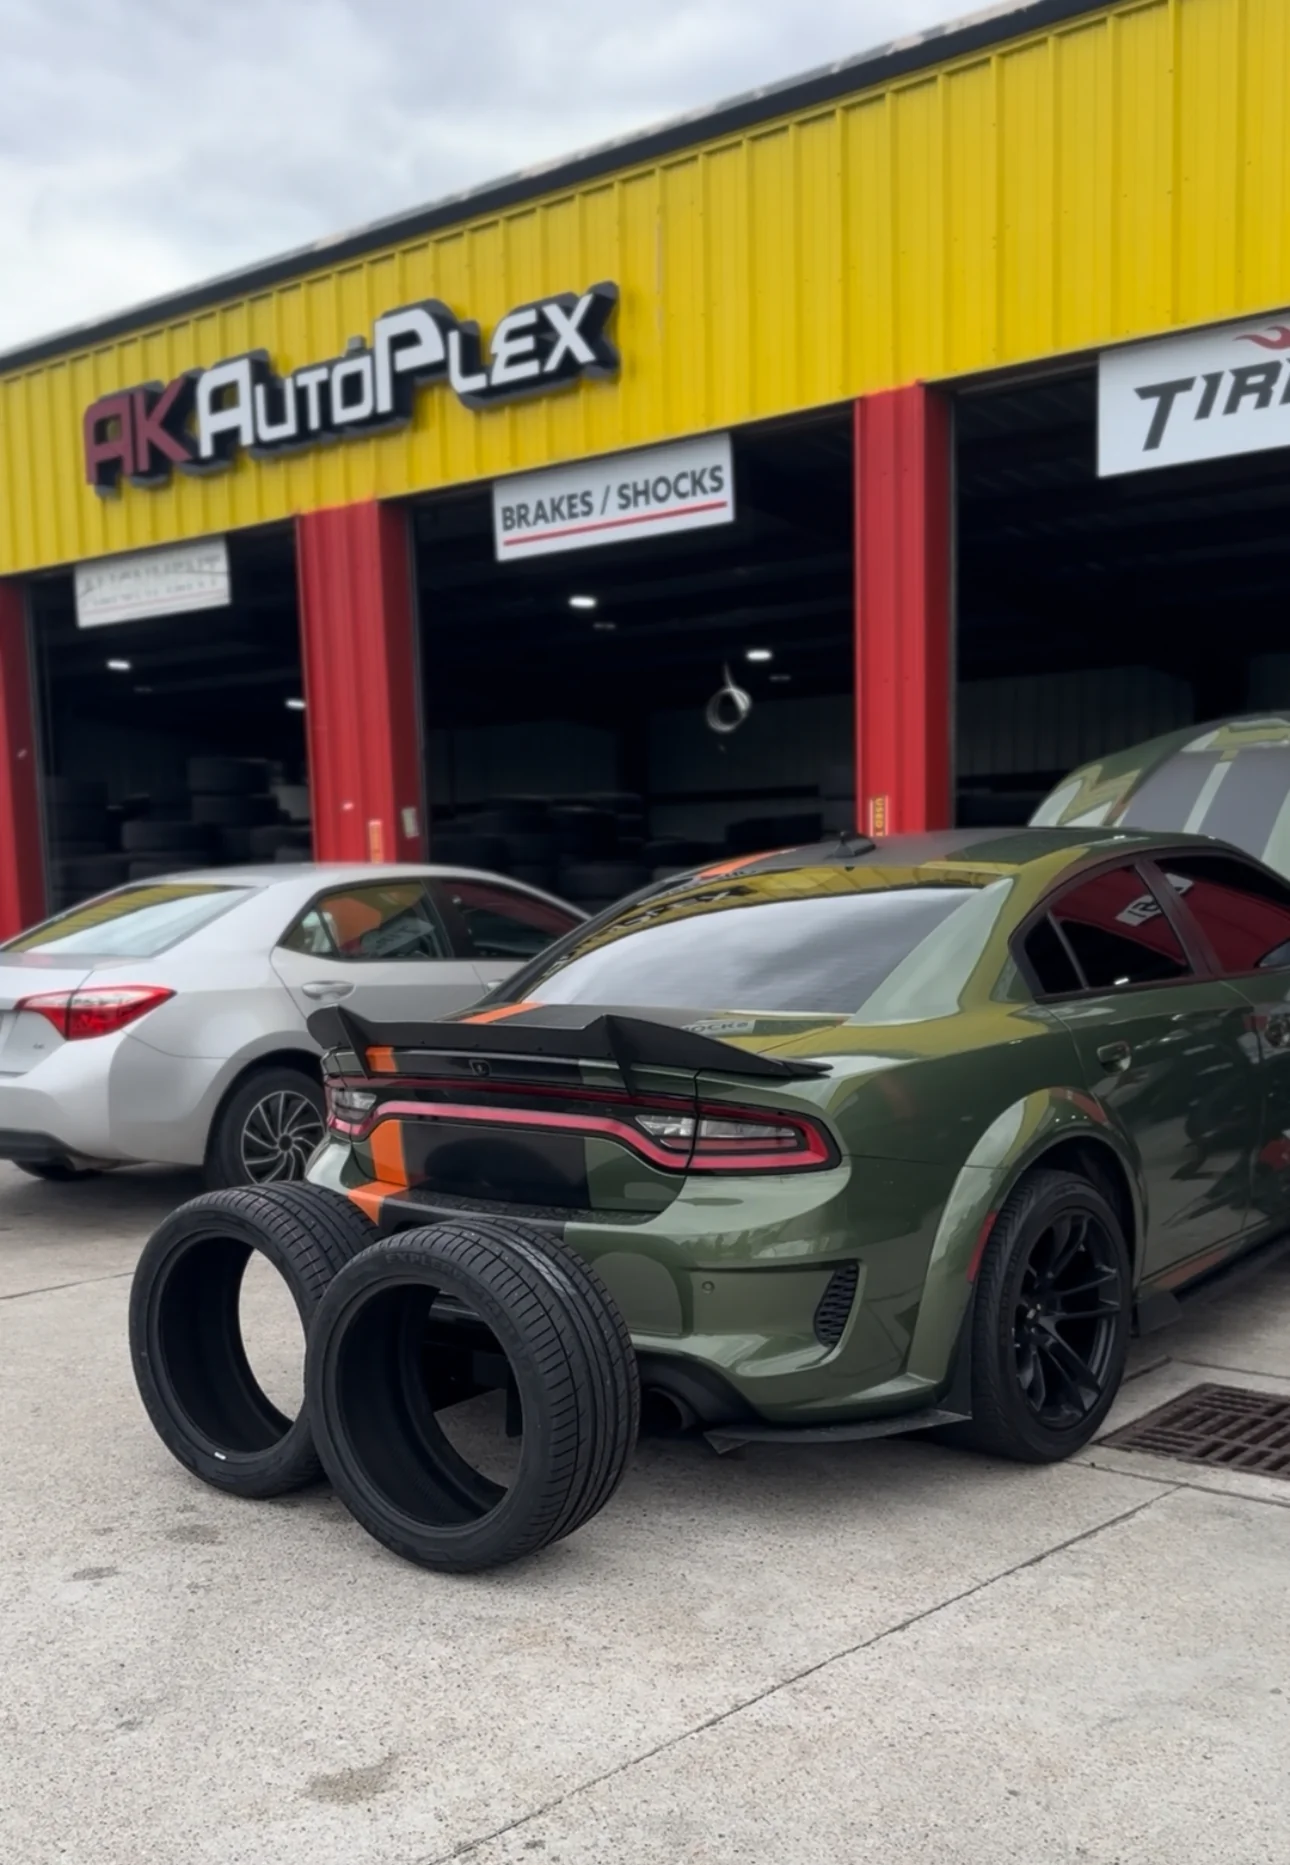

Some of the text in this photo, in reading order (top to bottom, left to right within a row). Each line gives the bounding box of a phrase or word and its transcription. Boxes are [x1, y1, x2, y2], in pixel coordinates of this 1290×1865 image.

[83, 376, 192, 486] AK
[501, 464, 725, 532] BRAKES / SHOCKS
